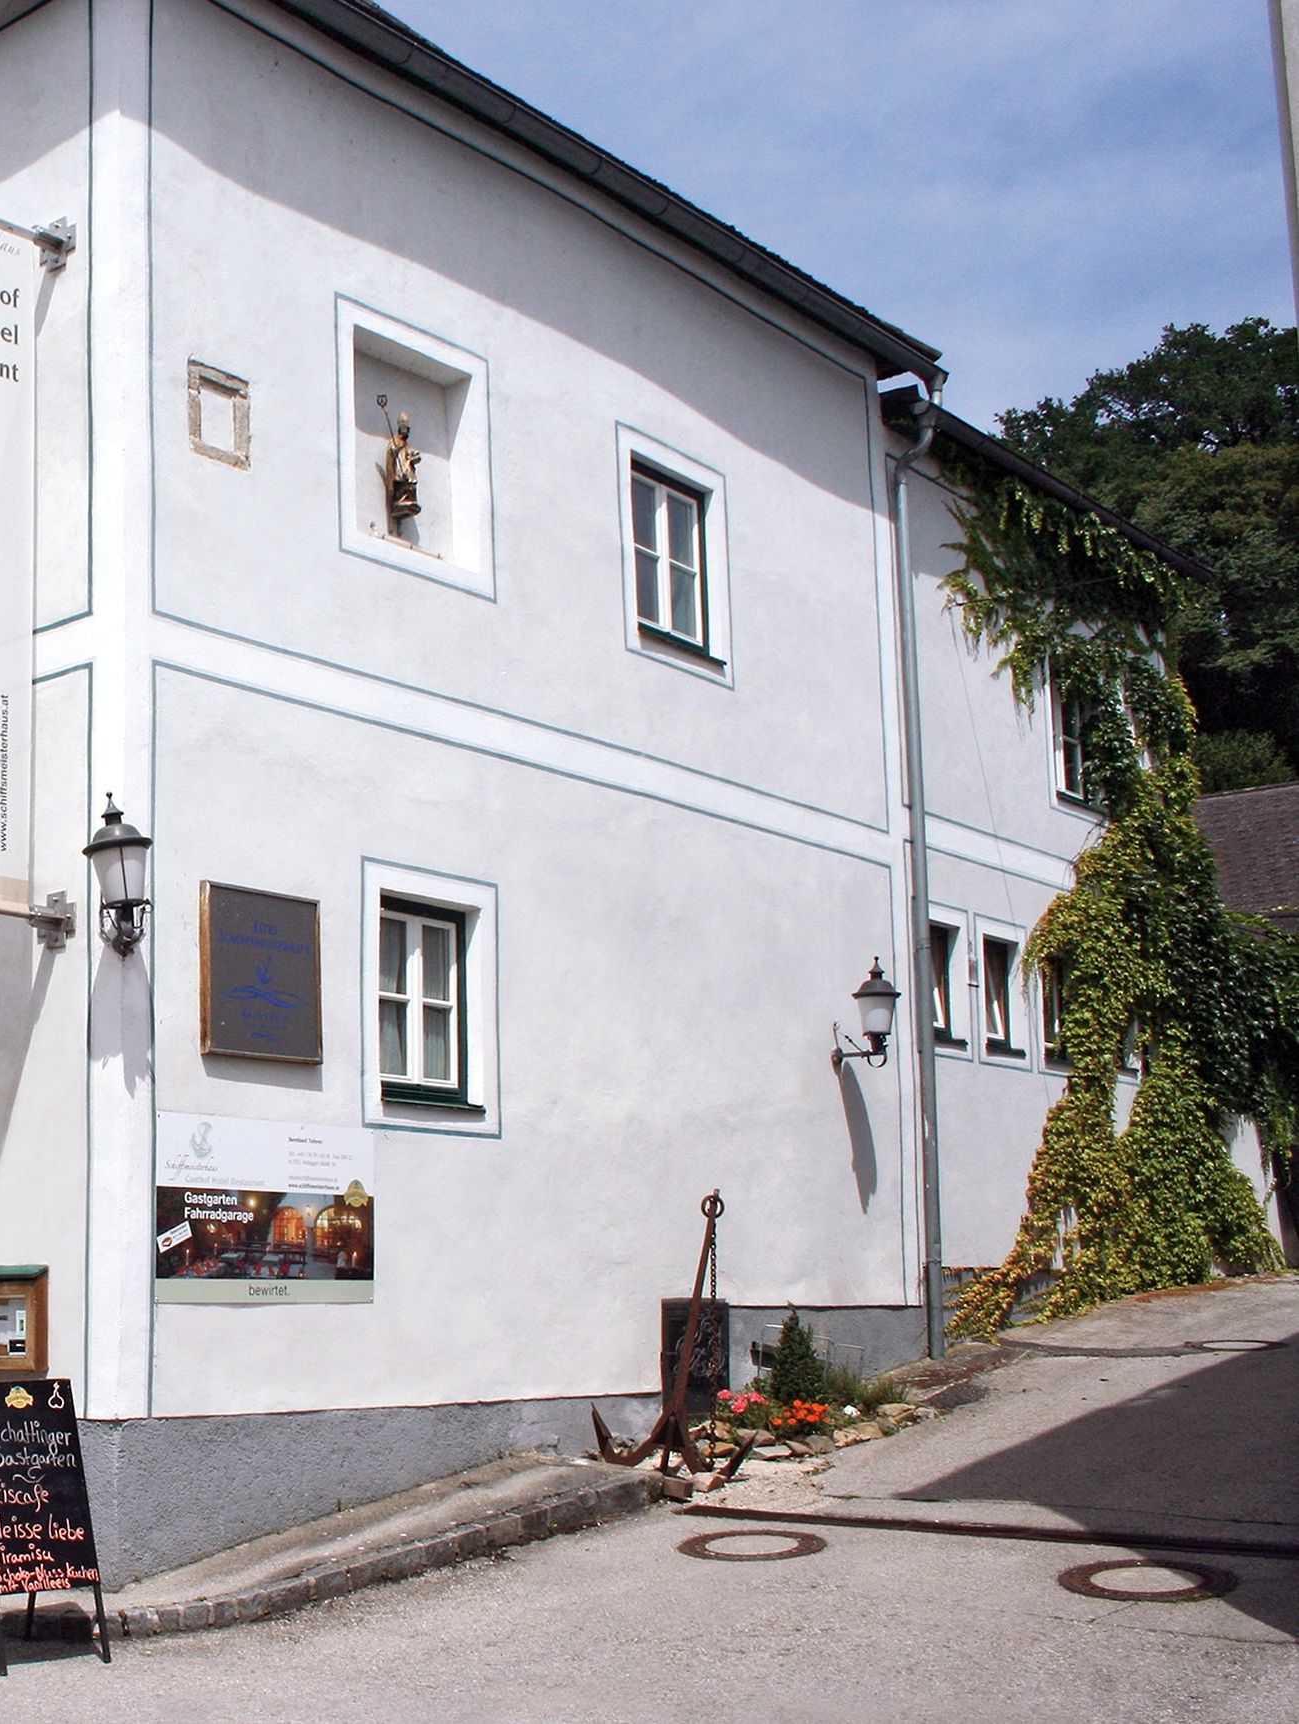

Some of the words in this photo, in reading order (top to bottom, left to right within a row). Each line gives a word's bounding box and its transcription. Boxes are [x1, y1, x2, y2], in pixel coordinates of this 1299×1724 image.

[0, 694, 10, 852] www.schiffsmeisterhaus.at
[184, 1191, 238, 1207] Gastgarten
[184, 1207, 254, 1224] Fahrradgarage
[248, 1284, 291, 1297] bewirtet.
